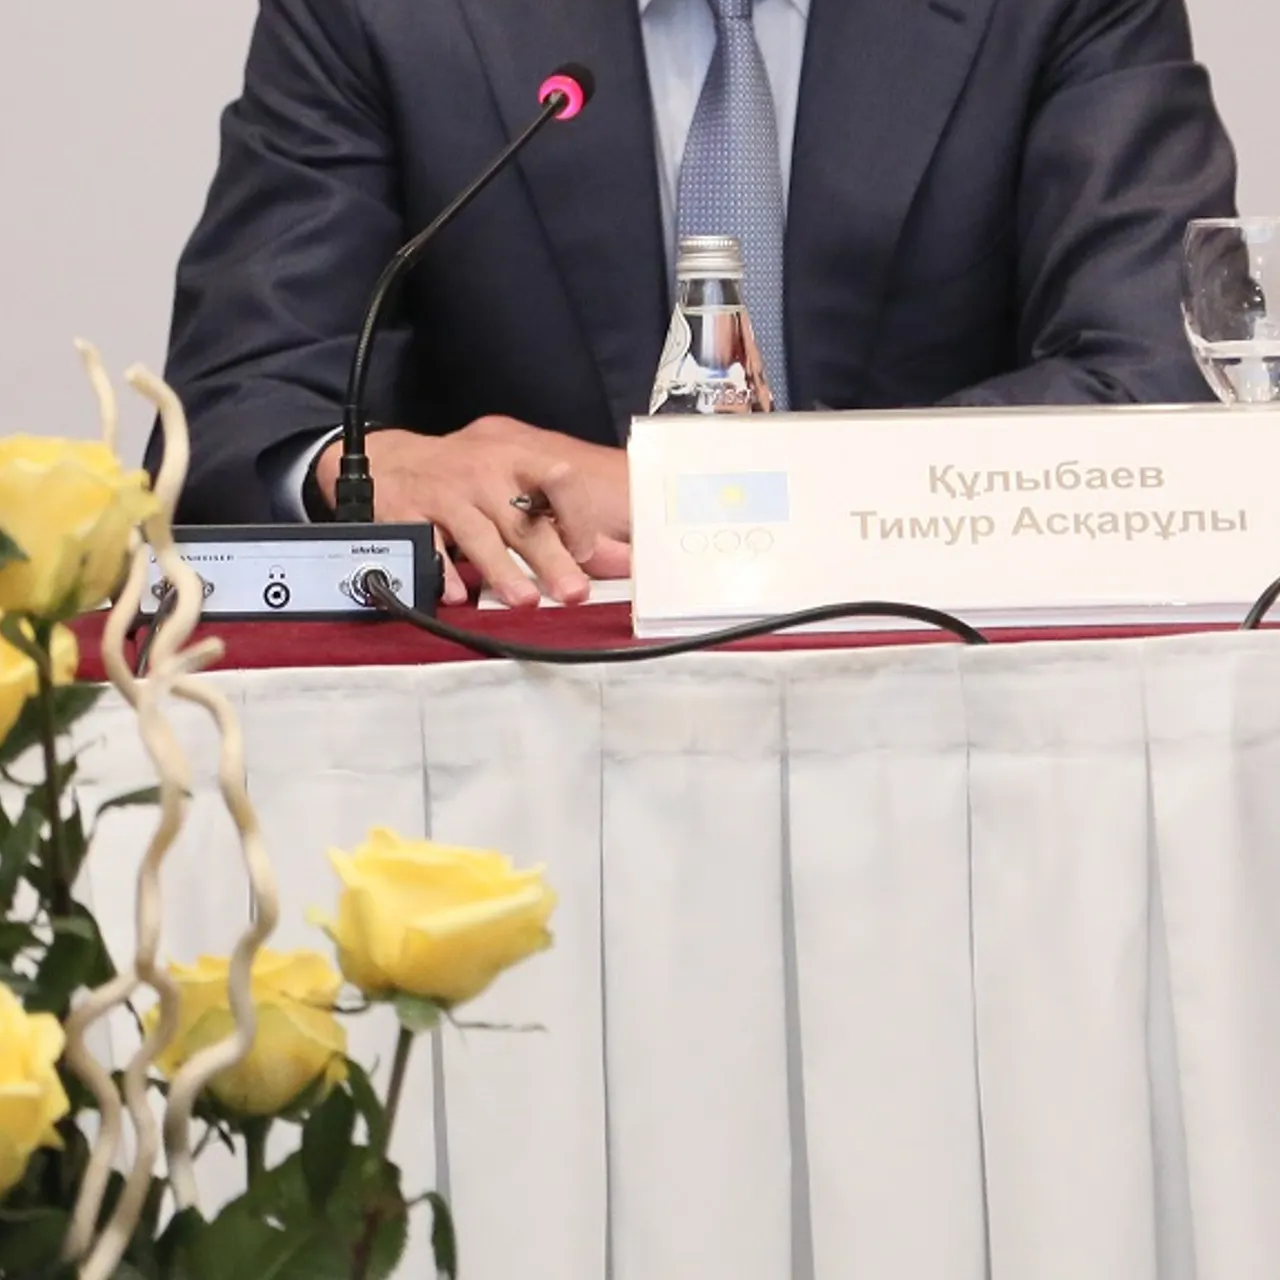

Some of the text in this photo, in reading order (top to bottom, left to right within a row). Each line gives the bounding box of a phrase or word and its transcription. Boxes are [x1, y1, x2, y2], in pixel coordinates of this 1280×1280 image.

[927, 459, 1165, 499] Құлыбаев
[849, 505, 1248, 545] Тимур Асқарұлы
